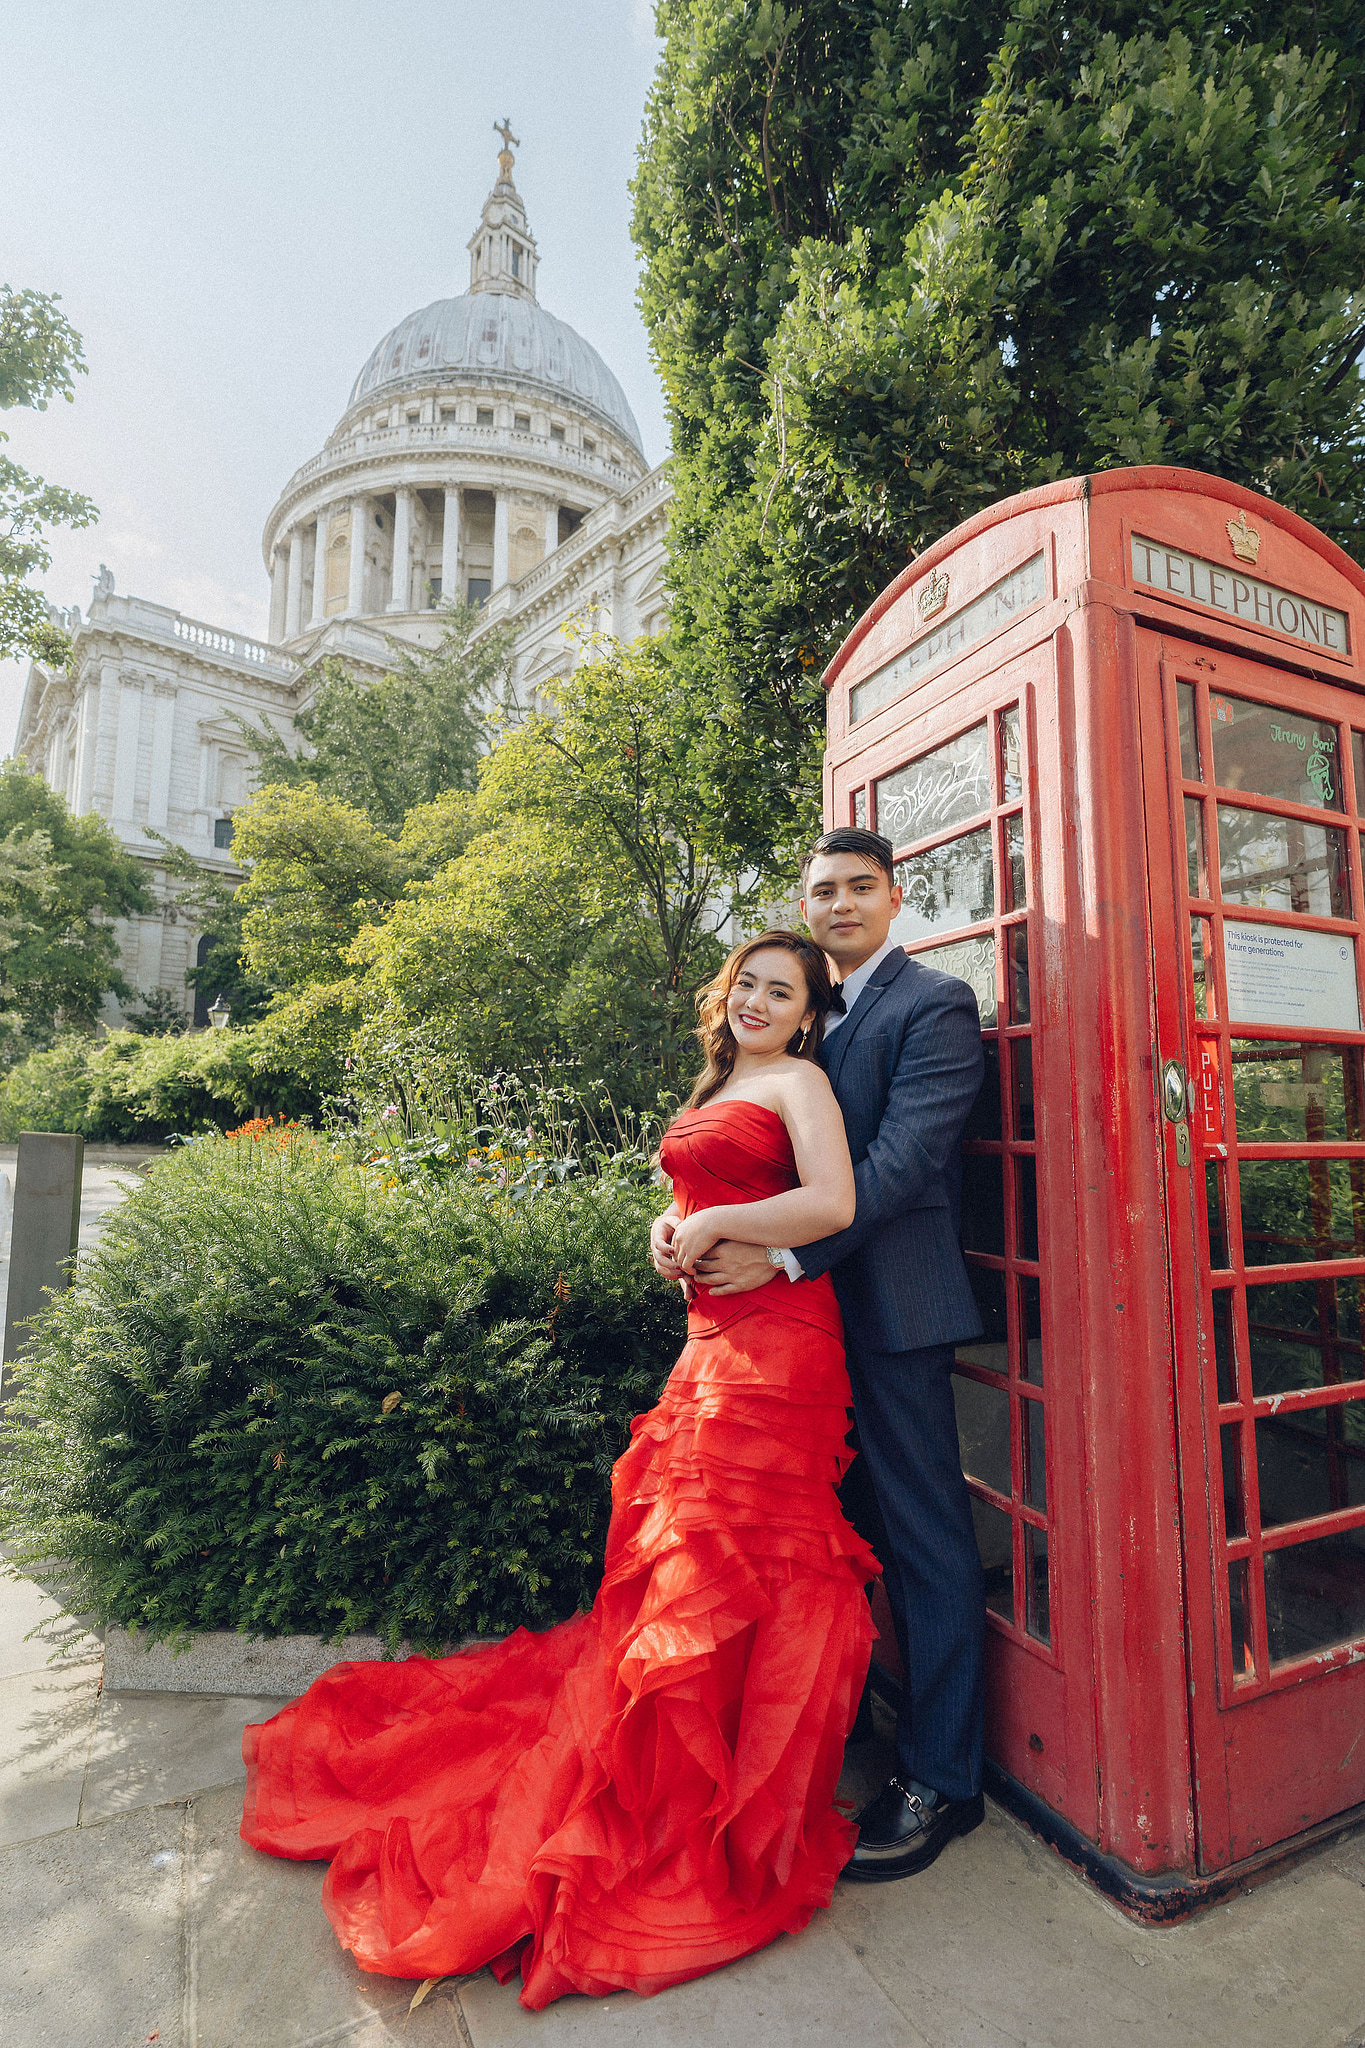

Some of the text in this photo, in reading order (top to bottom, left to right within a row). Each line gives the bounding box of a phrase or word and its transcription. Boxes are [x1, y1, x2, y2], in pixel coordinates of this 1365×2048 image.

[1135, 542, 1338, 649] TELEPHONE
[1270, 724, 1335, 753] Jeremy Boris
[1227, 930, 1303, 949] This kiosk is protected for
[1228, 941, 1285, 958] future generations
[1201, 1052, 1215, 1131] PULL
